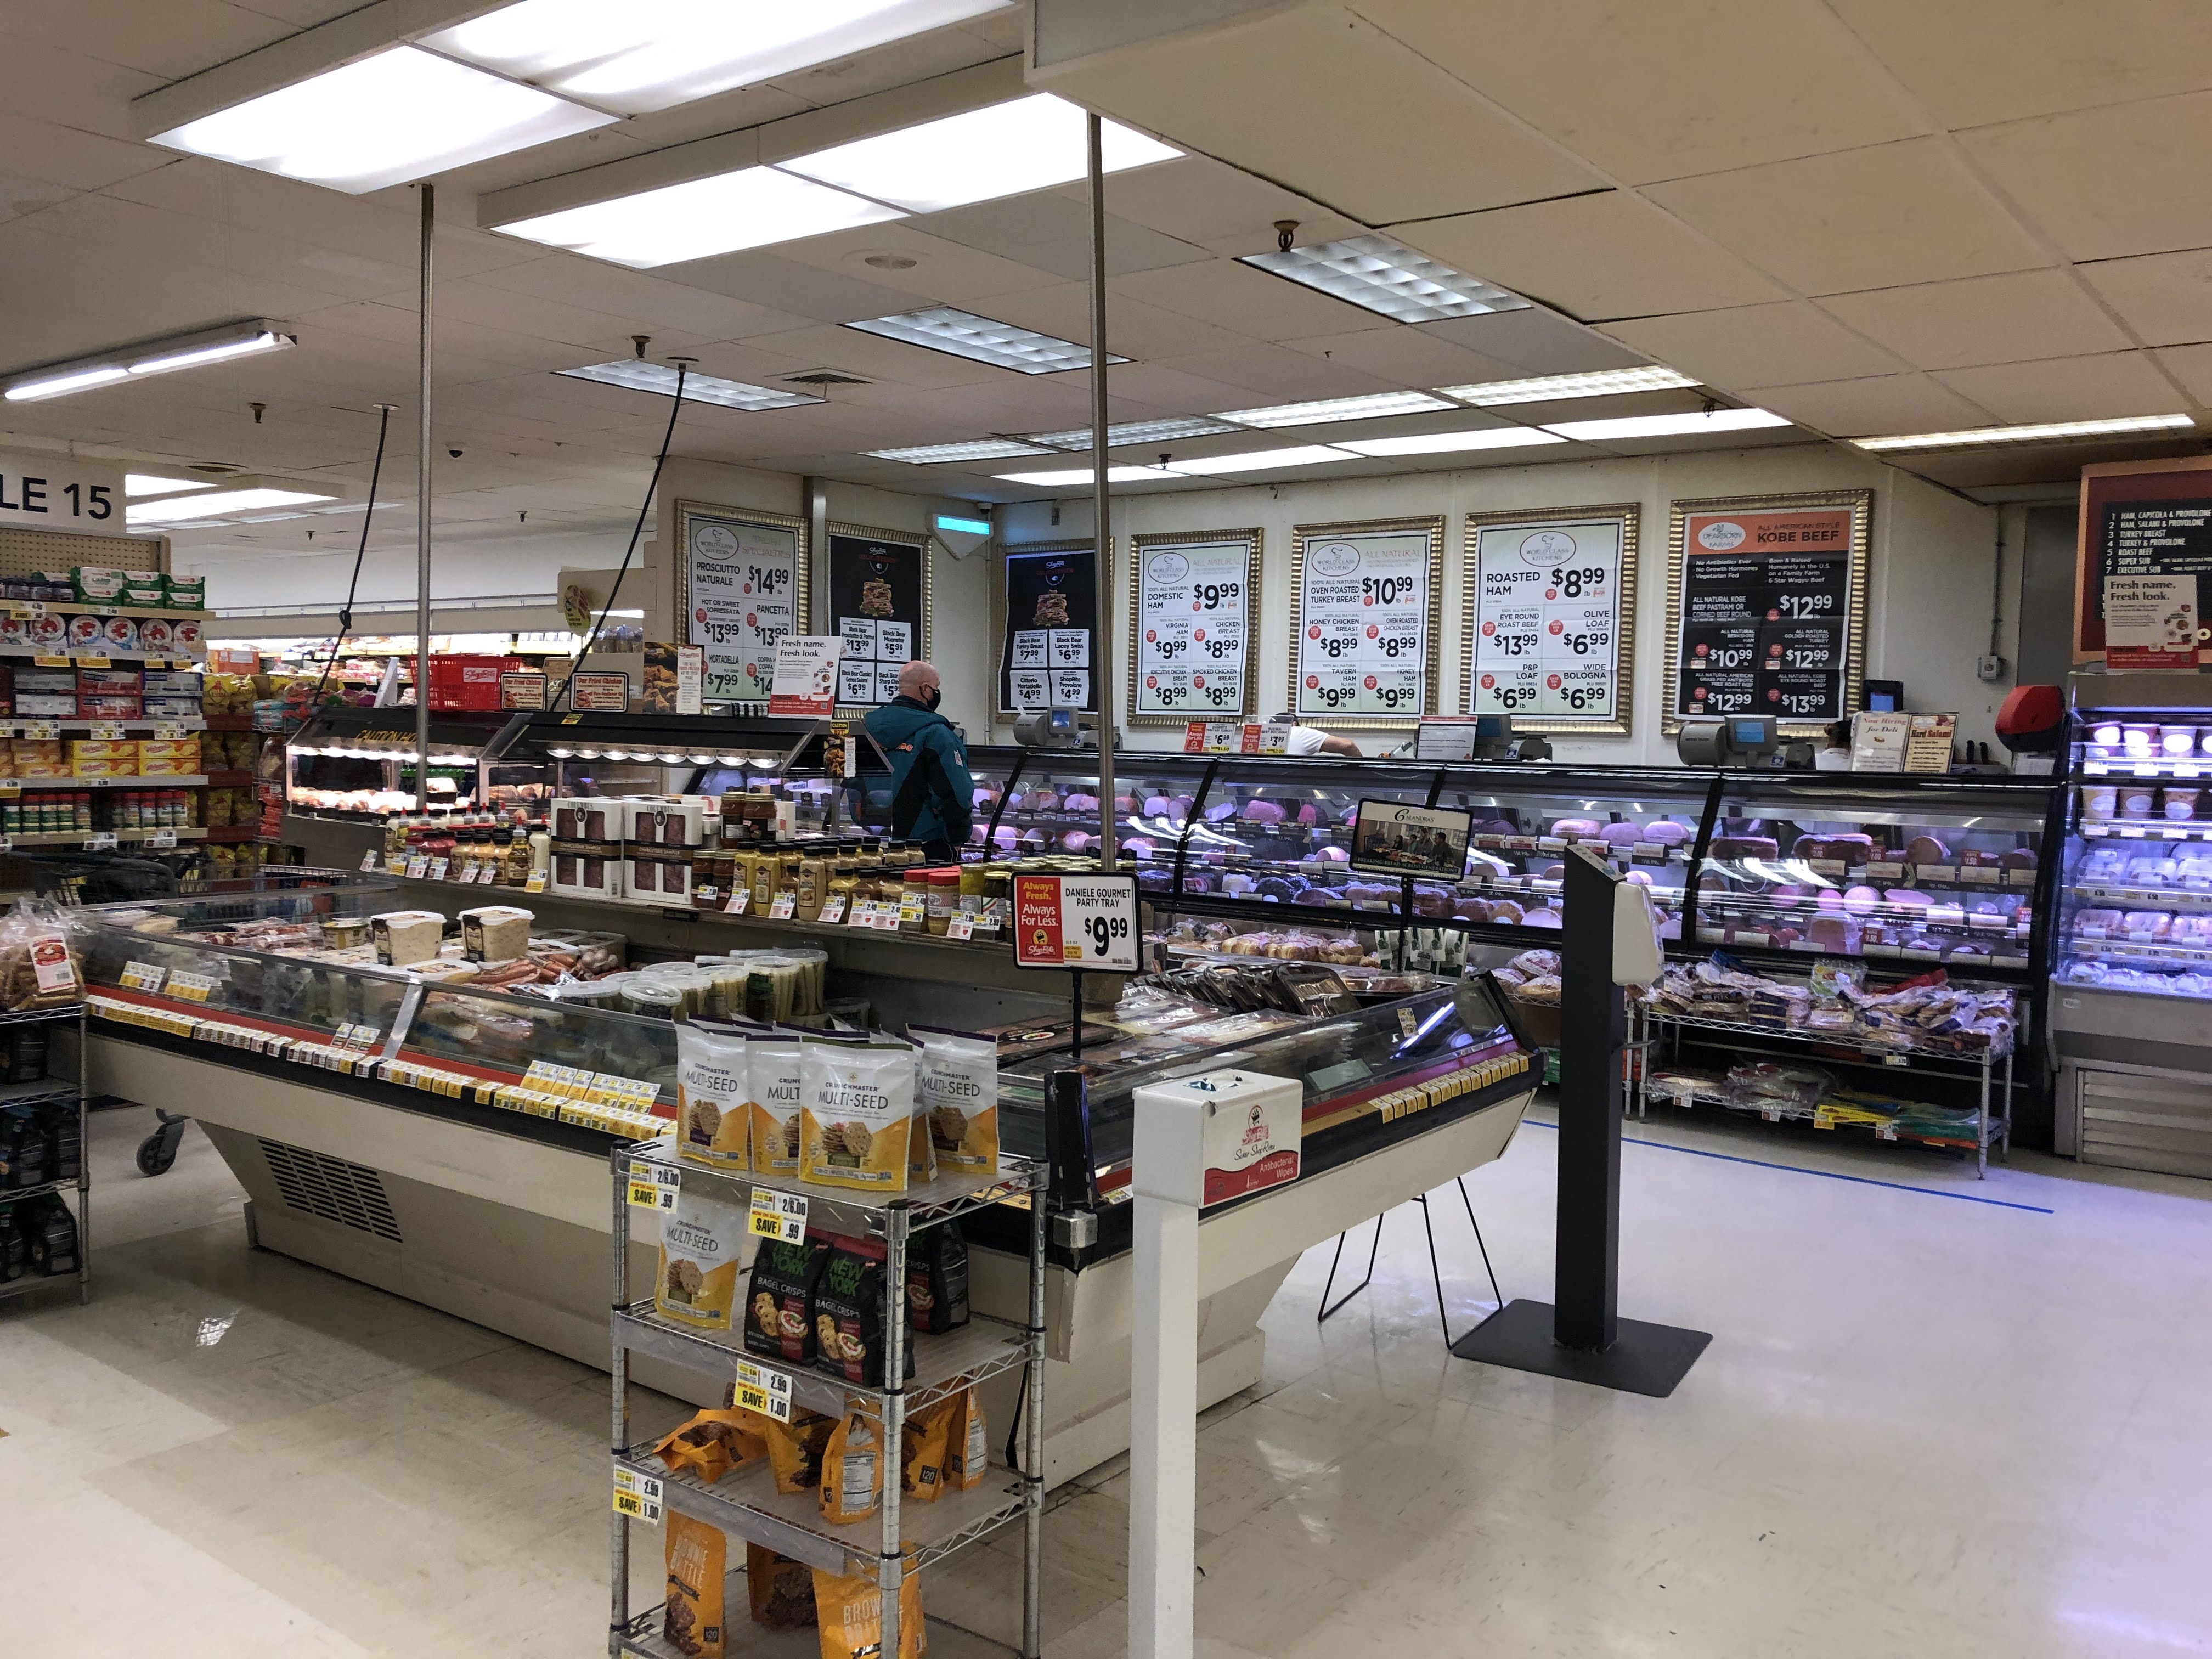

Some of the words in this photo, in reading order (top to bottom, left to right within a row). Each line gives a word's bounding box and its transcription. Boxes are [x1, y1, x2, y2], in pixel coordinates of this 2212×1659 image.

[64, 483, 111, 520] 15
[1758, 532, 1796, 543] KOBE
[1802, 531, 1839, 541] BEEF
[697, 562, 740, 574] PROSCIUTTO
[697, 574, 733, 586] NATURALE
[1487, 572, 1541, 583] ROASTED
[2111, 580, 2138, 589] Fresh
[1486, 586, 1511, 596] HAM
[2111, 592, 2139, 601] Fresh
[2143, 592, 2169, 600] look.
[757, 604, 789, 615] PANCETTA
[709, 654, 740, 664] MORTADELLA
[1023, 882, 1054, 893] Always
[1065, 888, 1094, 898] DANIELE
[1097, 889, 1131, 898] GOURMET
[1026, 891, 1052, 900] Fresh.
[1076, 898, 1099, 907] PARTY
[1101, 899, 1119, 908] TRAY
[1023, 904, 1056, 917] Always
[1021, 915, 1035, 926] For
[1037, 915, 1059, 927] Less.
[922, 1076, 980, 1097] MULTI-SEED
[818, 1091, 888, 1109] MULTI-SEED
[1260, 1155, 1294, 1173] Antibacterial
[1276, 1167, 1294, 1179] Wipes
[634, 1189, 653, 1204] SAVE
[782, 1198, 806, 1216] 2/6.00
[756, 1217, 777, 1234] SAVE
[666, 1226, 719, 1252] MULTI-SEED
[830, 1259, 865, 1280] NEW
[757, 1277, 779, 1291] BAGEL
[781, 1284, 806, 1298] CRISPS
[830, 1274, 860, 1297] YORK
[815, 1299, 837, 1313] BAGEL
[771, 1376, 787, 1393] 2.99
[742, 1390, 763, 1408] SAVE
[770, 1399, 787, 1418] 1.00
[922, 1470, 935, 1480] 120
[619, 1496, 637, 1513] SAVE
